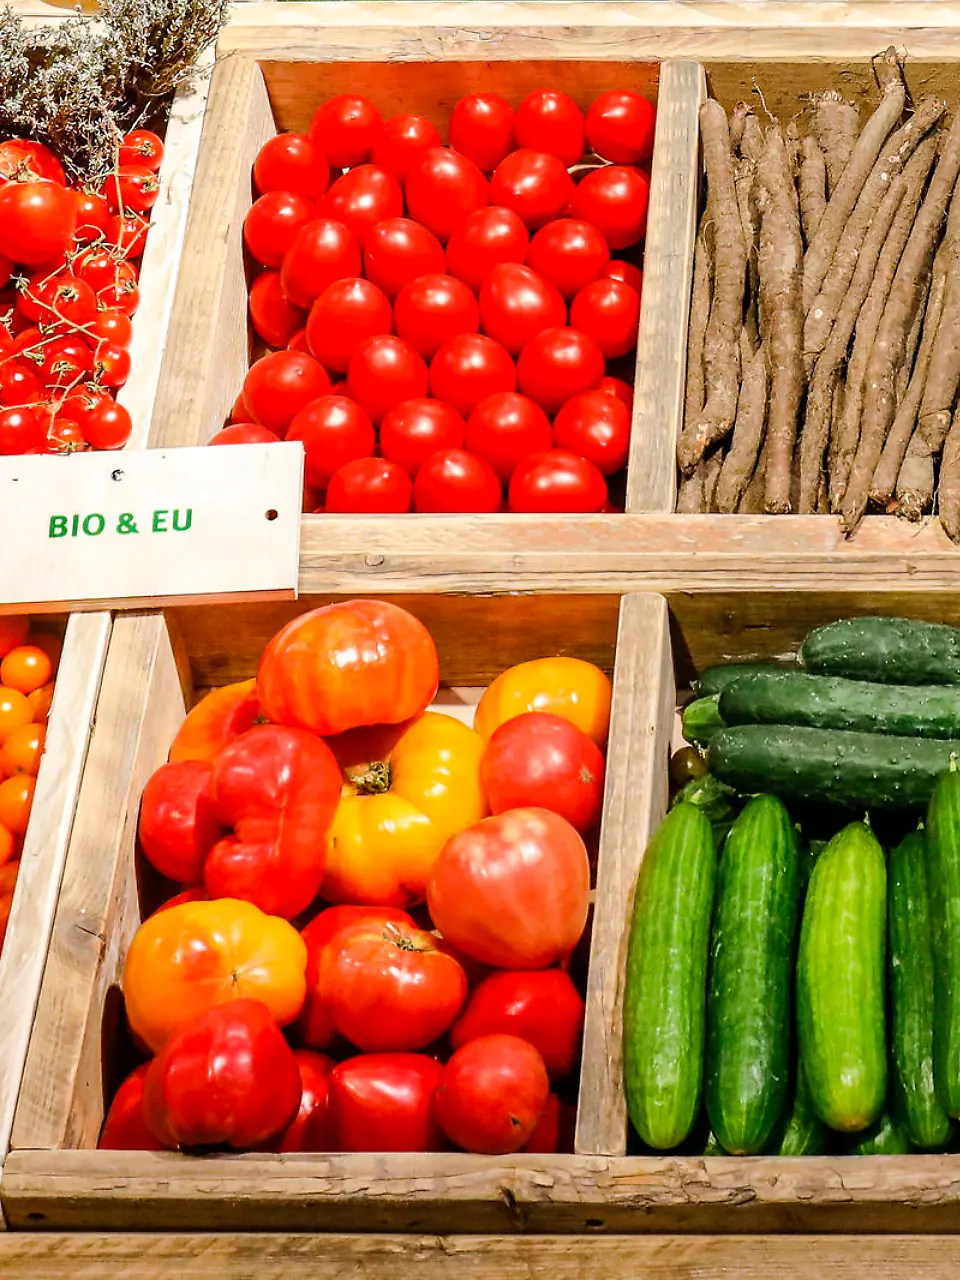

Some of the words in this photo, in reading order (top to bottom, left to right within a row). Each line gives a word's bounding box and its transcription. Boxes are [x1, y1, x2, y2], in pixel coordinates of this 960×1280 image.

[48, 512, 105, 538] BIO
[115, 512, 140, 535] &
[151, 508, 193, 532] EU
